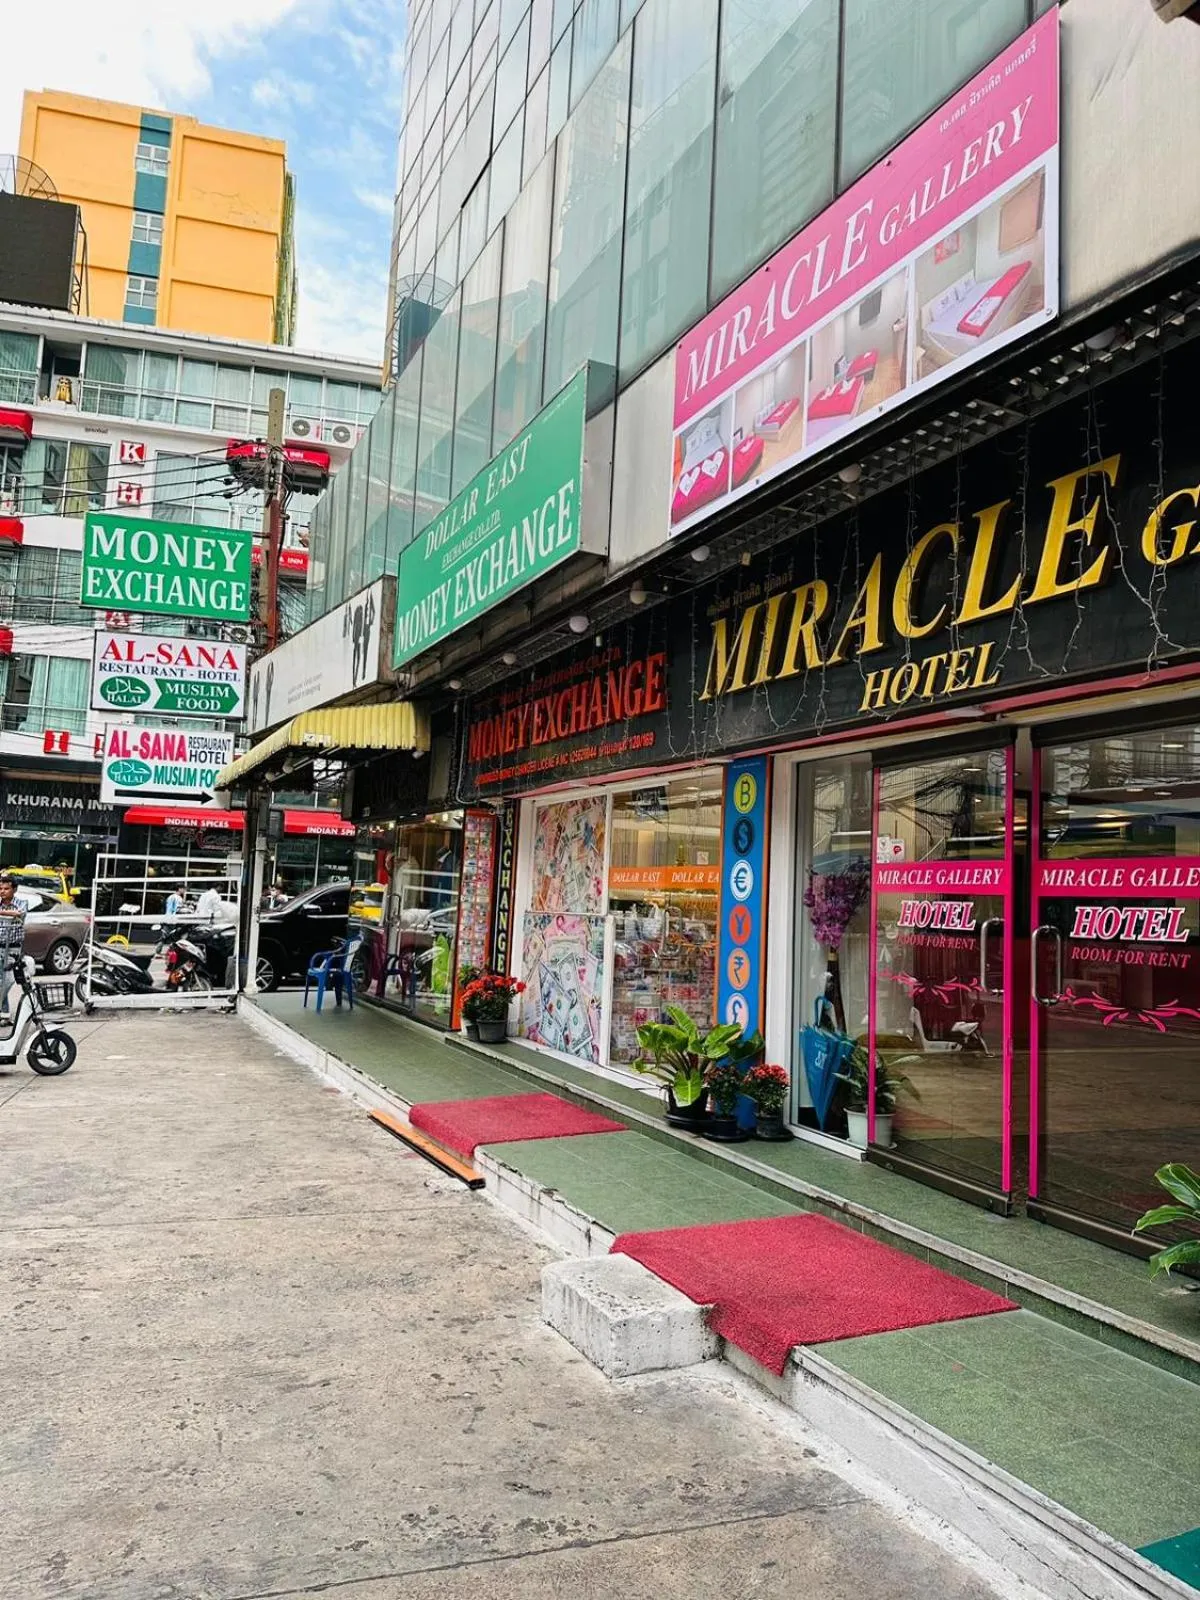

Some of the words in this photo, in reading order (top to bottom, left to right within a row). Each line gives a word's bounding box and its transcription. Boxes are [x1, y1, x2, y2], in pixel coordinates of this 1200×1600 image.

[682, 199, 875, 404] MIRACLE
[879, 95, 1033, 246] GALLERY
[424, 487, 478, 560] DOLLAR
[484, 433, 532, 506] EAST
[89, 525, 245, 572] MONEY
[397, 579, 451, 656] MONEY
[454, 479, 575, 620] EXCHANGE
[699, 453, 1121, 701] MIRACLE
[1142, 484, 1200, 566] G
[85, 566, 246, 611] EXCHANGE
[101, 638, 239, 670] AL-SANA
[99, 662, 187, 678] RESTAURANT
[198, 670, 241, 682] HOTEL
[858, 642, 1001, 712] HOTEL
[107, 692, 144, 704] HALAL
[165, 683, 230, 698] MUSLIM
[177, 697, 221, 711] FOOD
[468, 703, 529, 764] MONEY
[531, 652, 667, 746] EXCHANGE
[107, 730, 188, 763] AL-SANA
[188, 736, 231, 752] RESTAURANT
[188, 750, 228, 765] HOTEL
[153, 765, 197, 787] MUSLIM
[6, 793, 84, 809] KHURANA
[87, 799, 114, 811] INN
[164, 817, 198, 827] INDIAN
[200, 819, 230, 829] SPICES
[306, 826, 338, 835] INDIAN
[613, 872, 639, 883] DOLLAR
[642, 871, 661, 883] EAST
[671, 872, 705, 883] DOLLAR
[877, 869, 933, 885] MIRACLE
[936, 868, 1004, 885] GALLERY
[1041, 868, 1125, 887] MIRACLE
[497, 807, 514, 974] EXCHANGE
[898, 900, 976, 931] HOTEL
[1070, 906, 1190, 942] HOTEL
[898, 933, 925, 946] ROOM
[926, 935, 945, 948] FOR
[945, 936, 976, 950] RENT
[1071, 946, 1113, 962] ROOM
[1115, 949, 1144, 965] FOR
[1148, 951, 1191, 969] RENT
